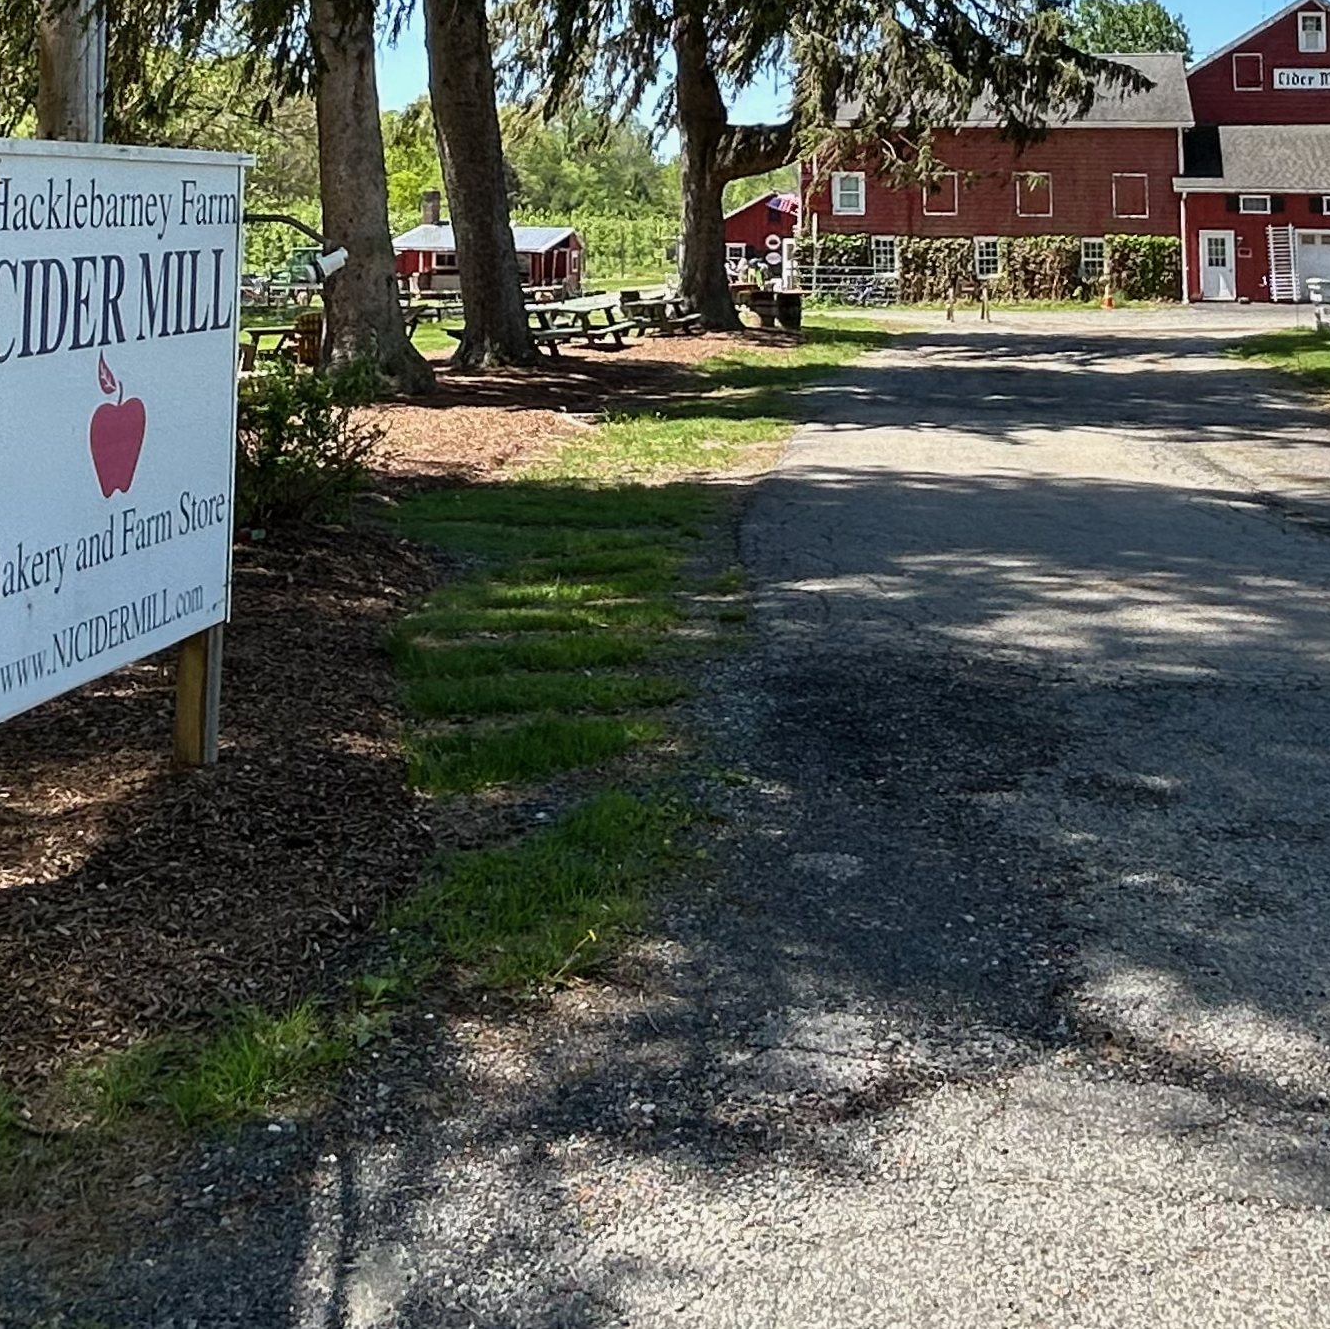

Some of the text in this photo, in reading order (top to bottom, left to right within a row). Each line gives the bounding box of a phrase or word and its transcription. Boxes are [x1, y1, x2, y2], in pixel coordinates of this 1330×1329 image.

[1278, 72, 1315, 86] Cider
[179, 180, 237, 226] Farm
[136, 248, 232, 340] MILL
[75, 514, 115, 572] and
[120, 507, 172, 556] Farm
[178, 491, 225, 536] Store
[0, 584, 204, 694] www.NJCIDERMILL.com
